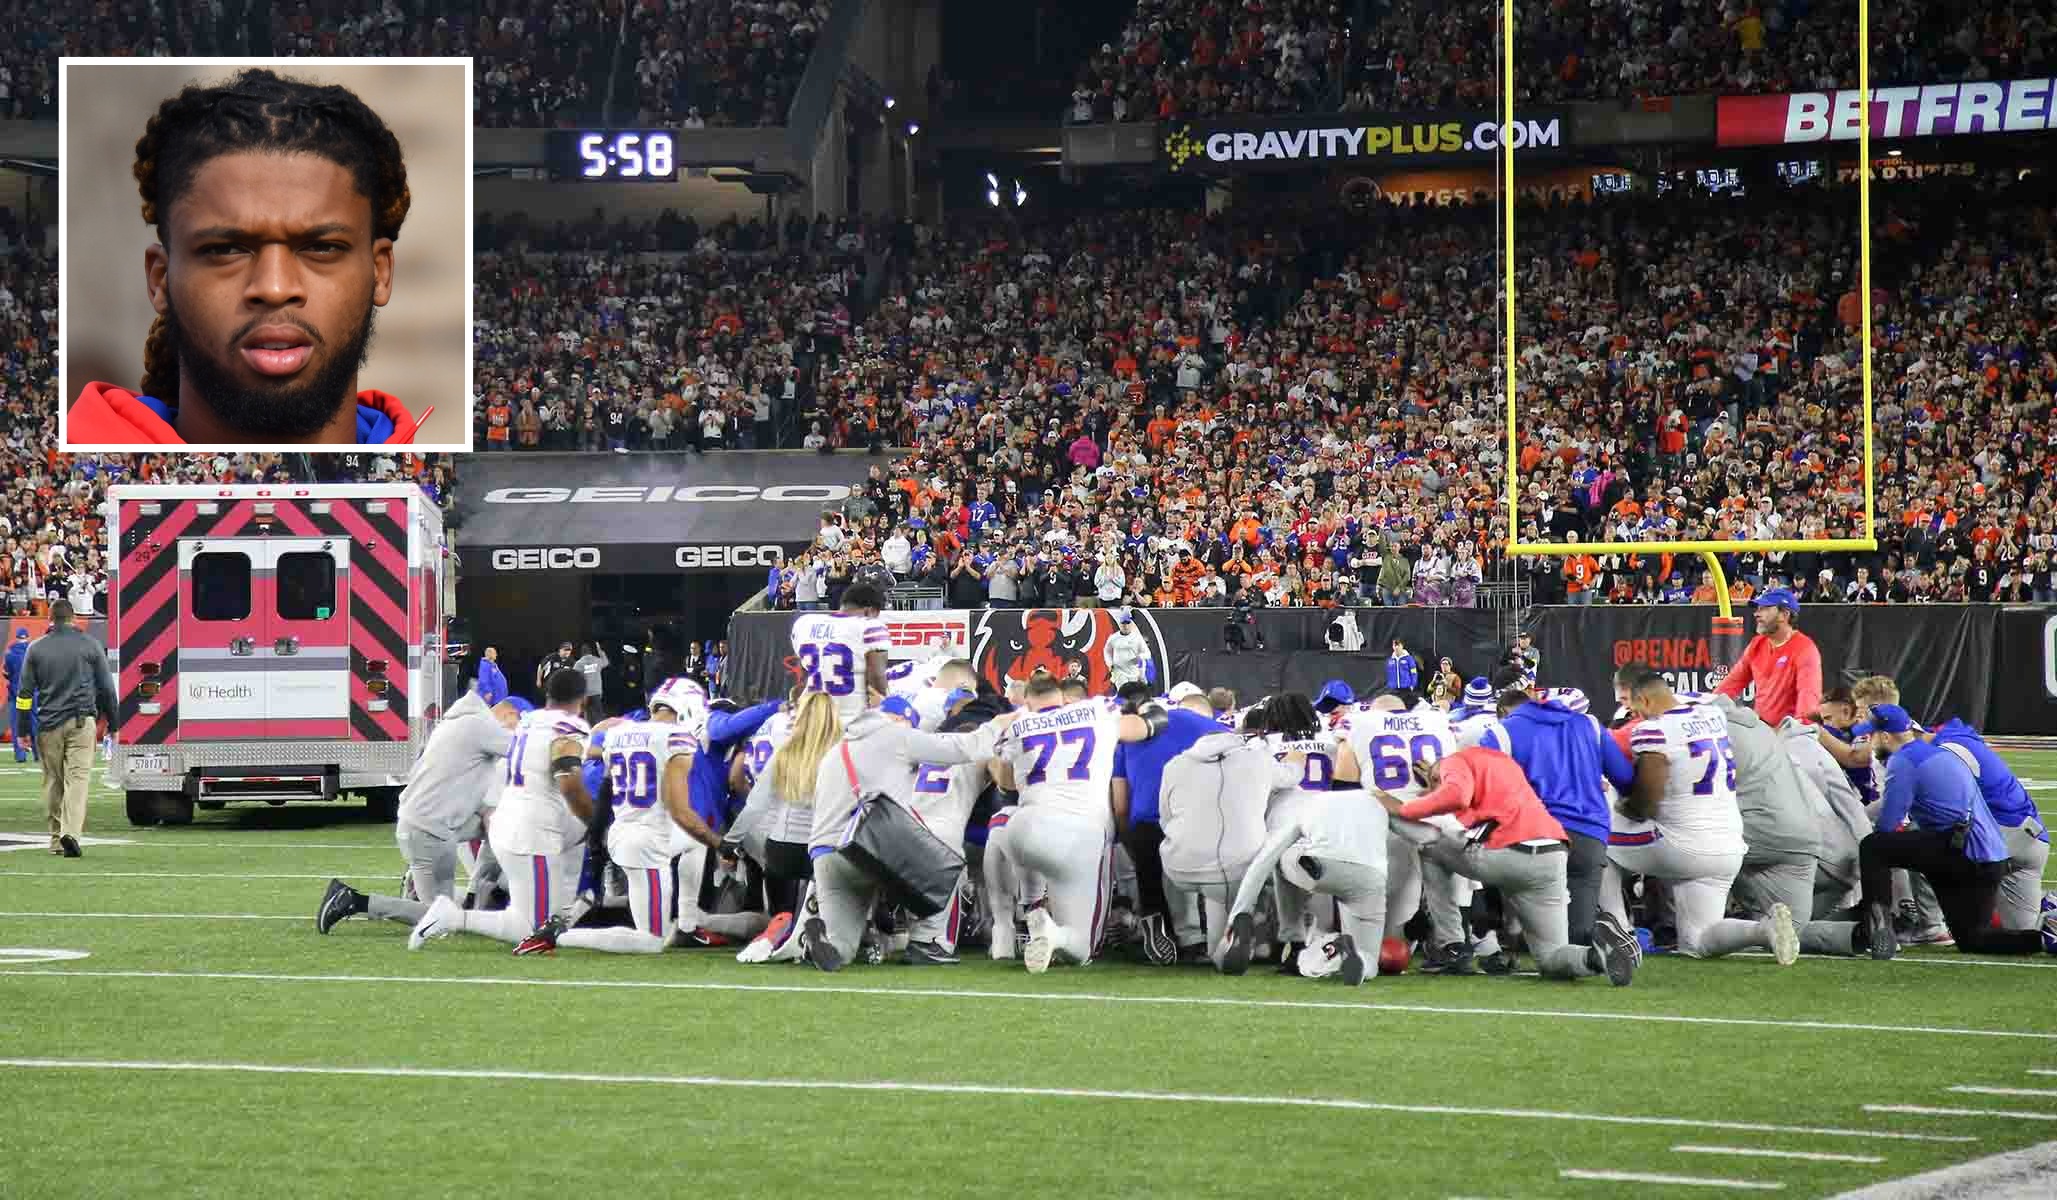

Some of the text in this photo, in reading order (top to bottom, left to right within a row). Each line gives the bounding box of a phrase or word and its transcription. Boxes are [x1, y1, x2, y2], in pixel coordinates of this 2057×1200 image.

[1784, 79, 2057, 144] BETFRE
[1206, 119, 1560, 161] GRAVITYPLUS.COM
[580, 134, 673, 177] 5:58
[609, 413, 623, 425] 94
[345, 455, 359, 468] 94
[484, 486, 852, 503] GEICO
[971, 508, 985, 522] 17
[492, 547, 601, 570] GEICO
[675, 544, 785, 568] GEICO
[1575, 563, 1584, 580] 9
[1978, 568, 1988, 585] 9
[809, 623, 836, 640] NEAL
[885, 622, 965, 646] ESPN
[799, 642, 855, 697] 33
[207, 684, 252, 699] Health
[1012, 706, 1097, 738] QUESSENBERRY
[1383, 716, 1424, 731] MORSE
[1022, 726, 1096, 786] 77
[1369, 734, 1443, 792] 60
